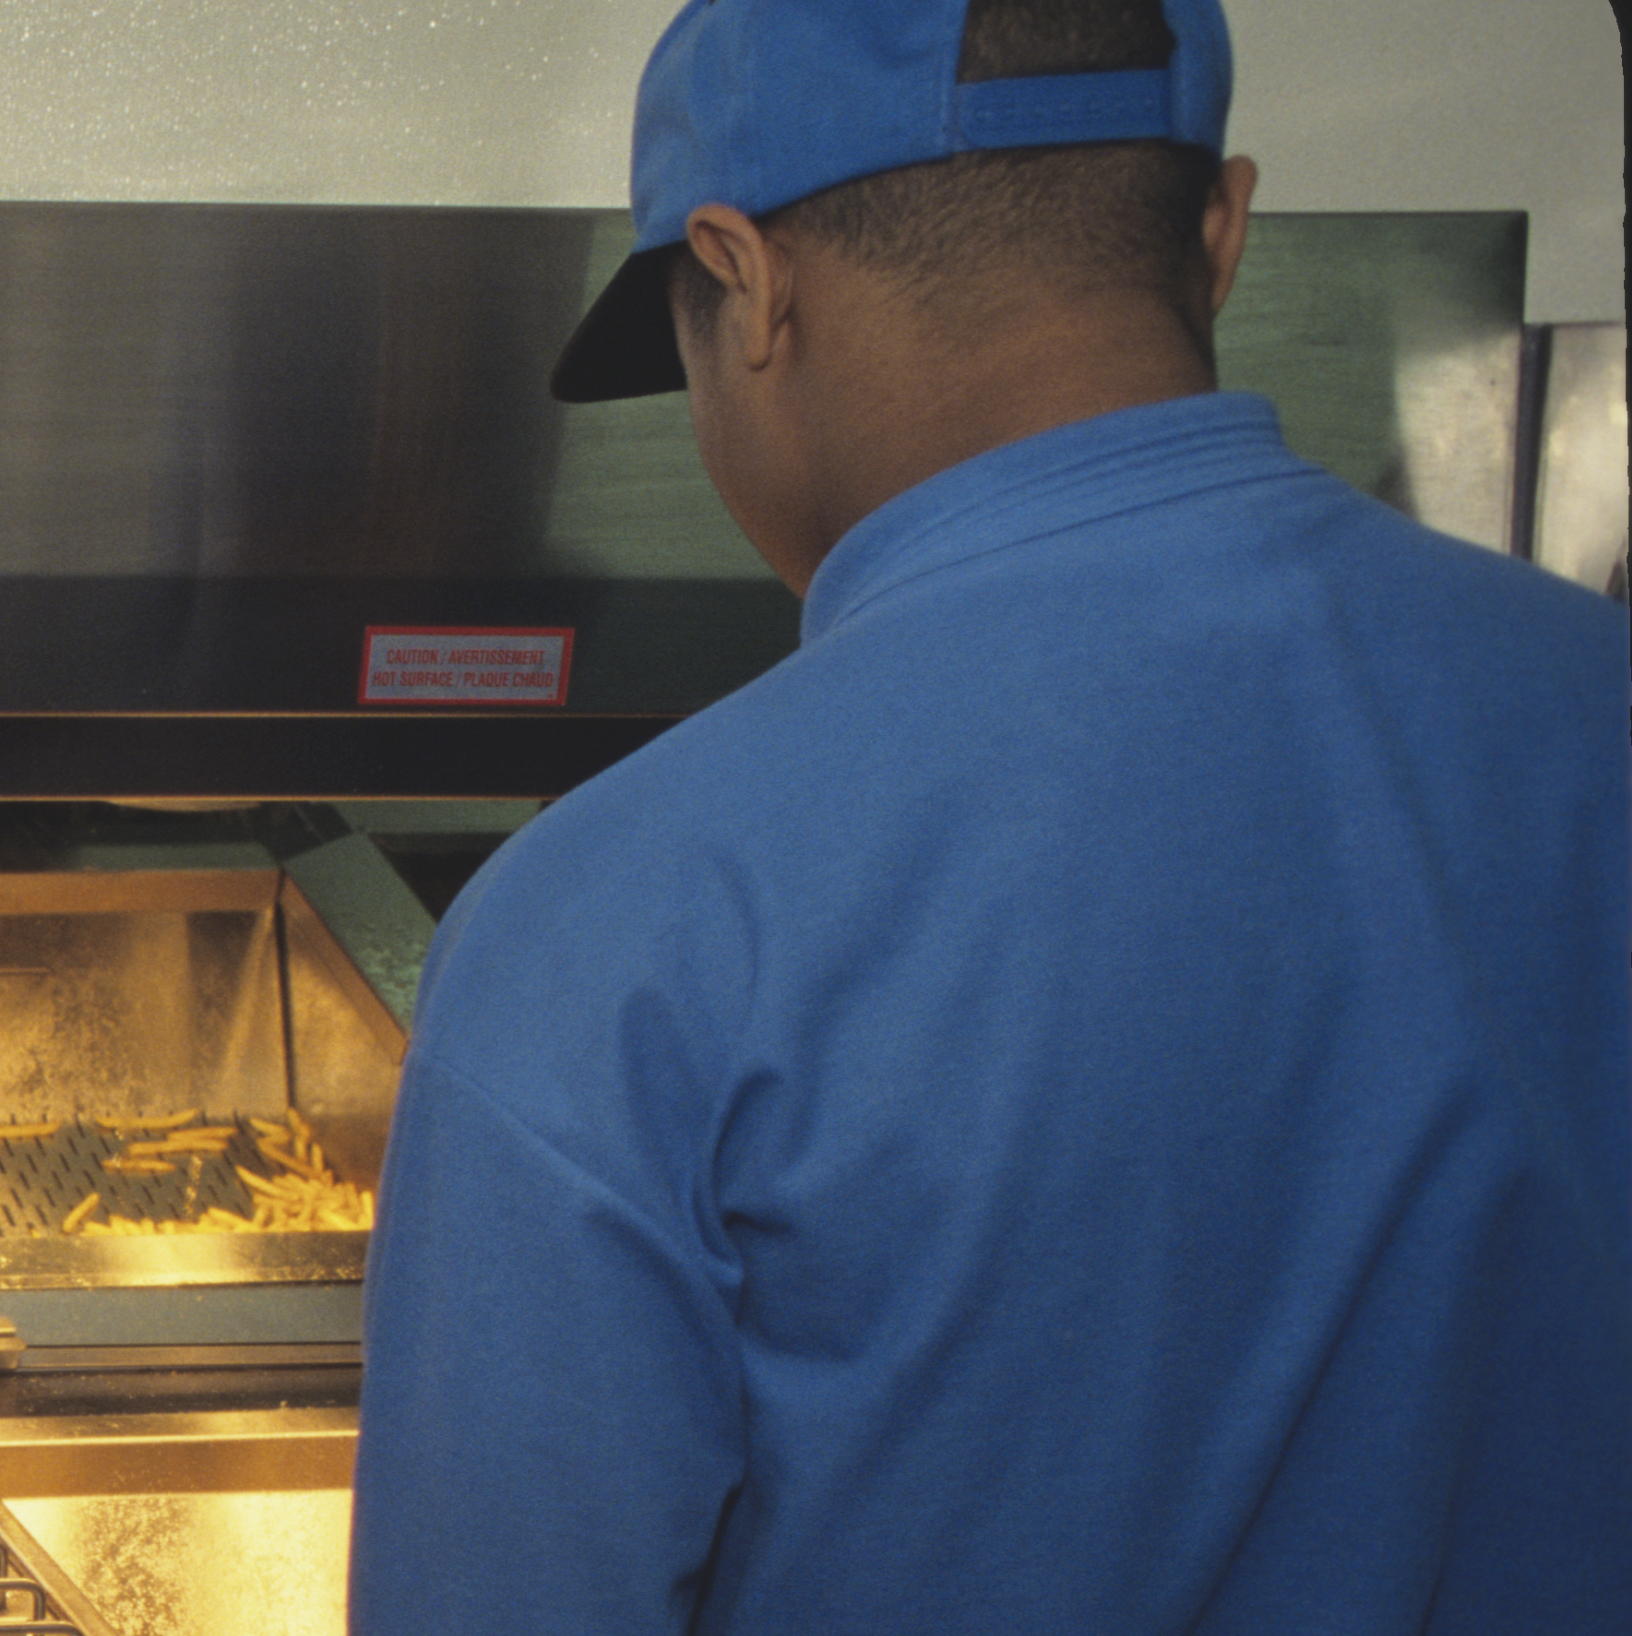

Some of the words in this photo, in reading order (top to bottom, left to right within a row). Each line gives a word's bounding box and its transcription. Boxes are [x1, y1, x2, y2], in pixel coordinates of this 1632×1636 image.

[387, 648, 437, 664] CAUTION
[449, 649, 546, 665] AVERTISSEMENT
[372, 672, 395, 686] HOT
[400, 671, 453, 687] SURFACE
[463, 672, 509, 687] PLAQUE
[512, 672, 554, 688] CHAUD
